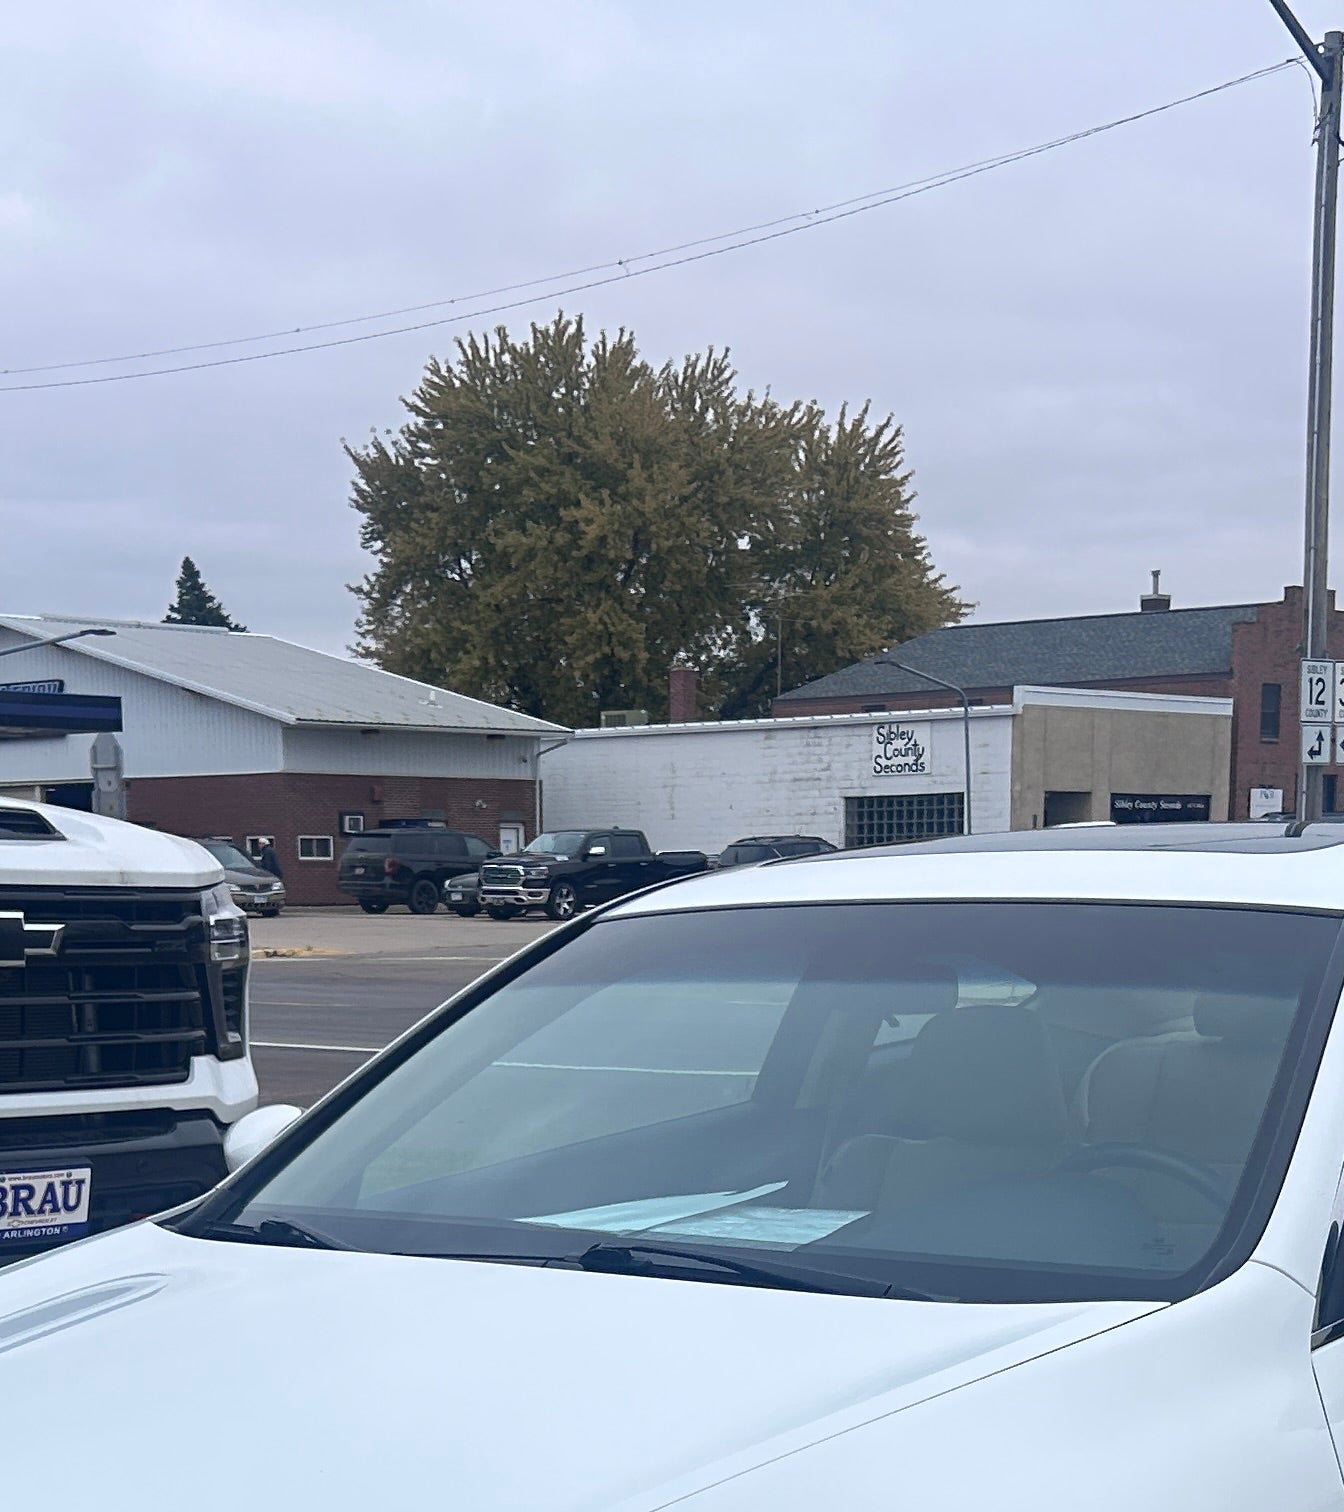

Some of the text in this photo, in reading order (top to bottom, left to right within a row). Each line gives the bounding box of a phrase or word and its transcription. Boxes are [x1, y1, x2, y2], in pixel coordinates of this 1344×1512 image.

[1307, 664, 1328, 675] SIBLEY
[1308, 677, 1326, 705] 12
[1305, 708, 1328, 718] COUNTY
[876, 724, 915, 746] Sibley
[884, 739, 925, 761] County
[873, 755, 926, 774] Seconds
[2, 1226, 61, 1240] ARLINGTON
